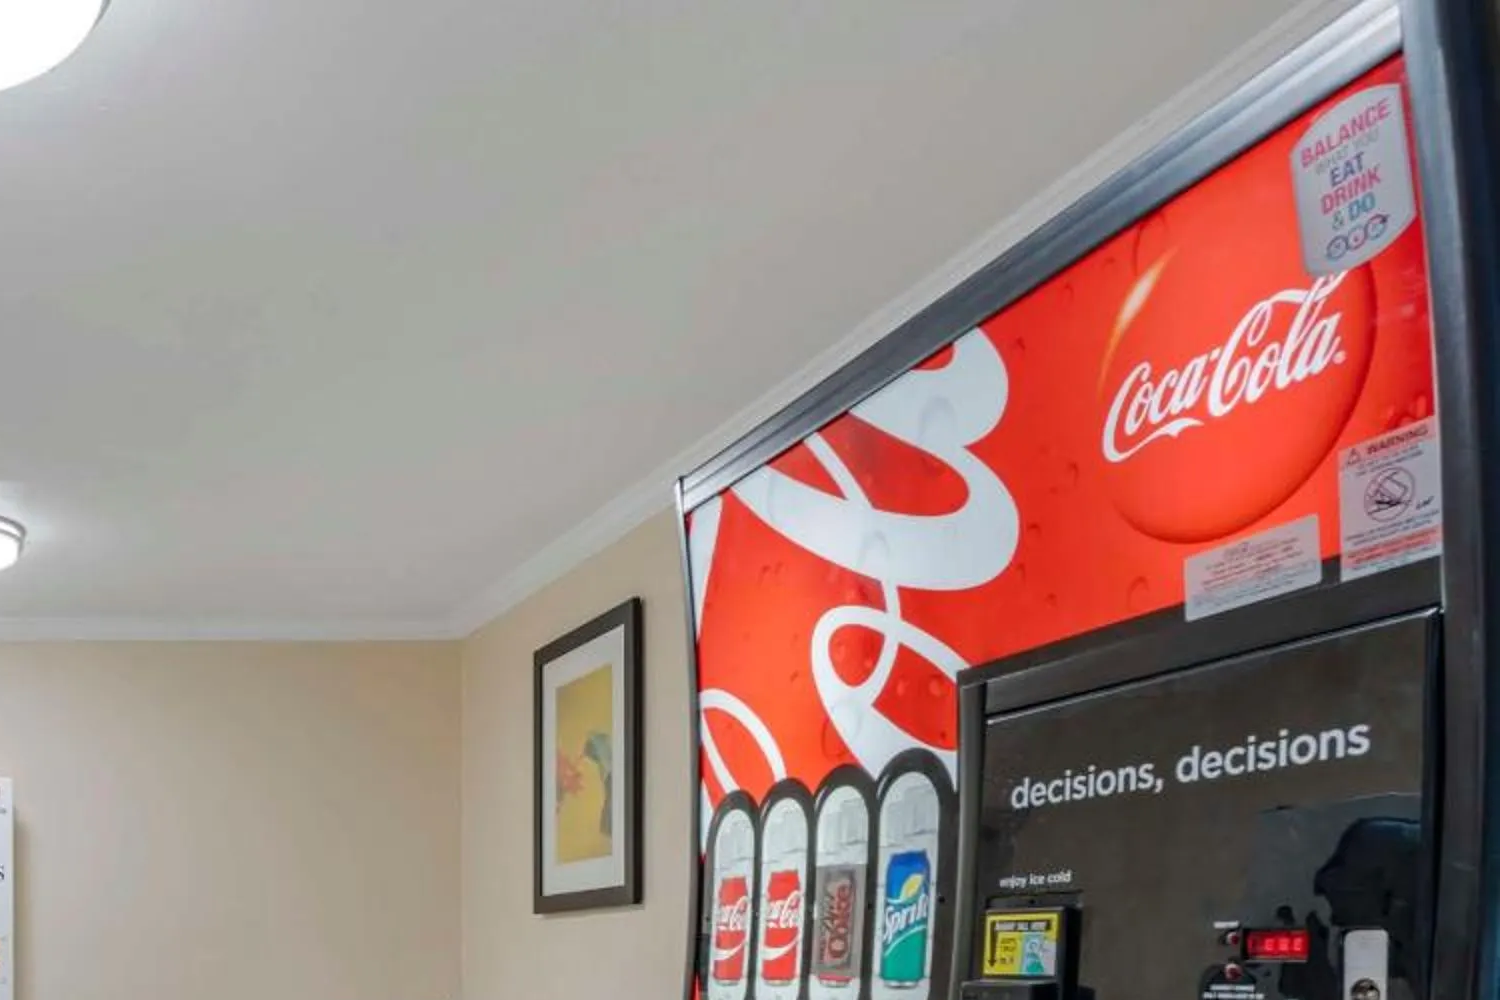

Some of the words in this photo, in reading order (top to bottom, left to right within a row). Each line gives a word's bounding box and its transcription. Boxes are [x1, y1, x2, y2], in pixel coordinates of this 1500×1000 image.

[1301, 98, 1392, 168] BALANCE
[1320, 164, 1382, 214] DRINK
[1329, 152, 1365, 187] EAT
[1348, 192, 1376, 221] DO
[1102, 270, 1344, 463] Coca-Cola
[1010, 761, 1165, 810] decisions,
[1175, 722, 1372, 784] decisions
[999, 874, 1028, 889] enjoy
[1029, 872, 1045, 885] ice
[1047, 869, 1073, 884] cold
